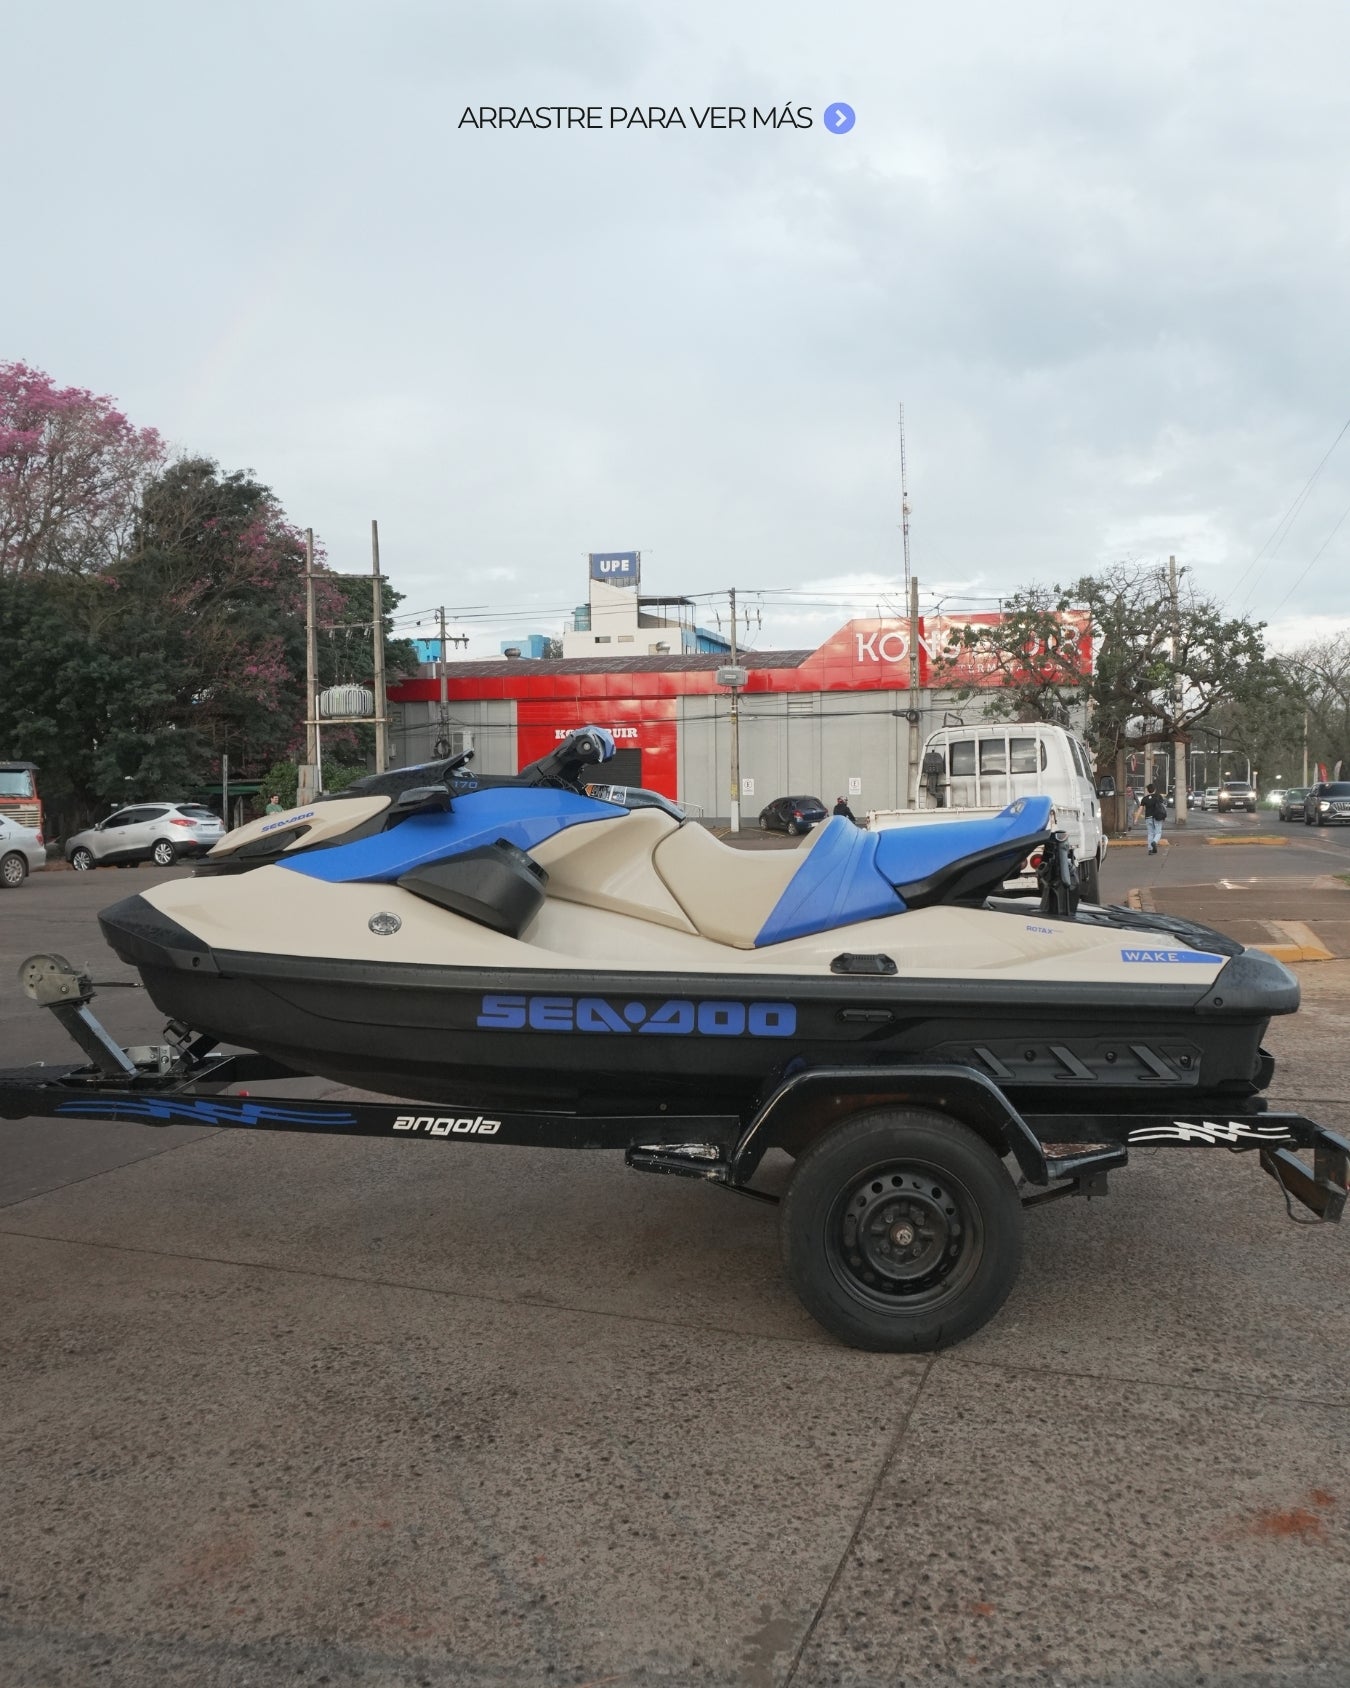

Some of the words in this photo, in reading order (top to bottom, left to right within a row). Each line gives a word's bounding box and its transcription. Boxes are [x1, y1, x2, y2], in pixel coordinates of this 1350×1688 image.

[600, 559, 630, 573] UPE
[855, 625, 1083, 663] KONSUR
[555, 728, 639, 740] KOUIR
[454, 781, 478, 789] 170
[1026, 925, 1054, 935] ROTAX
[1125, 951, 1180, 962] WAKE
[392, 1116, 502, 1136] angola
